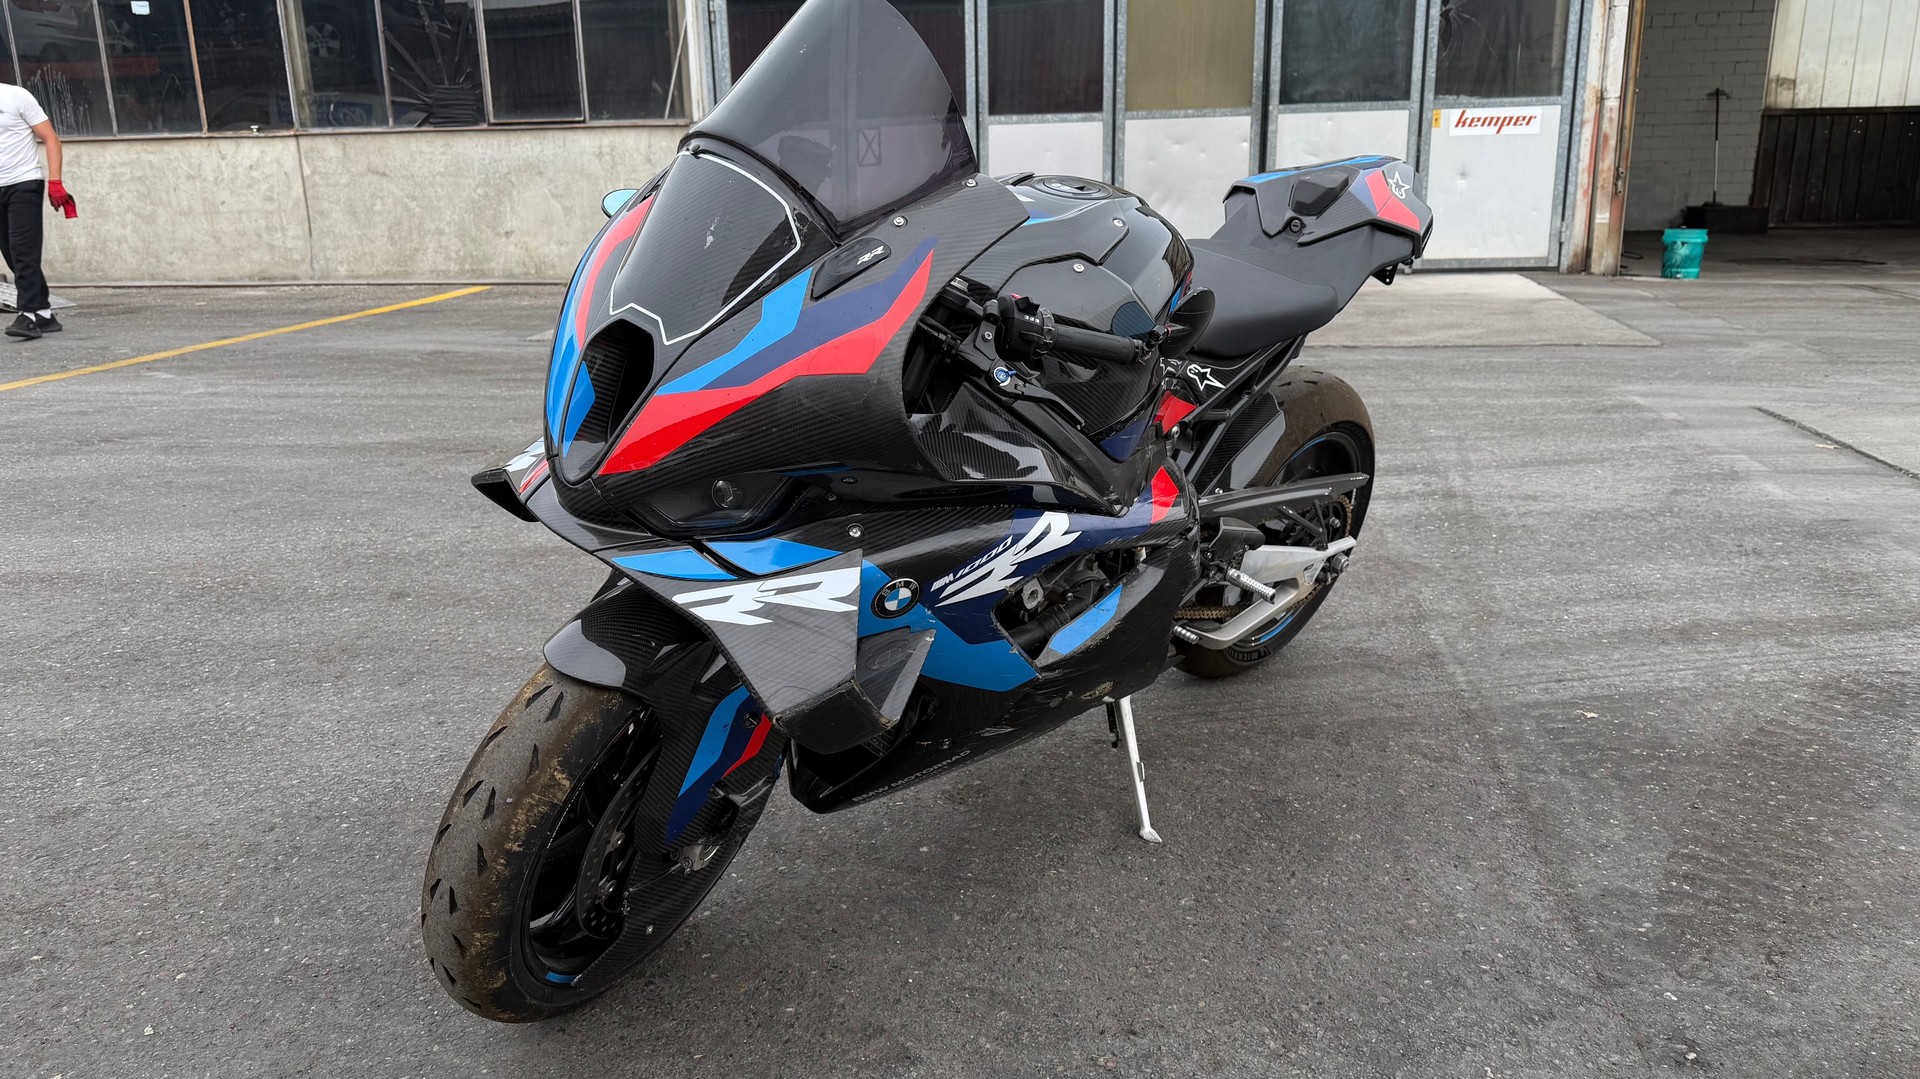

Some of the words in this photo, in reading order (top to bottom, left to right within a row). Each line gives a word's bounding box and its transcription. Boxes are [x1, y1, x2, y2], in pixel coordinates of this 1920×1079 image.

[1454, 109, 1537, 134] kemper
[671, 566, 861, 626] RR
[881, 581, 917, 597] BMW
[852, 785, 889, 802] BMW
[891, 750, 971, 787] MOTORRAD
